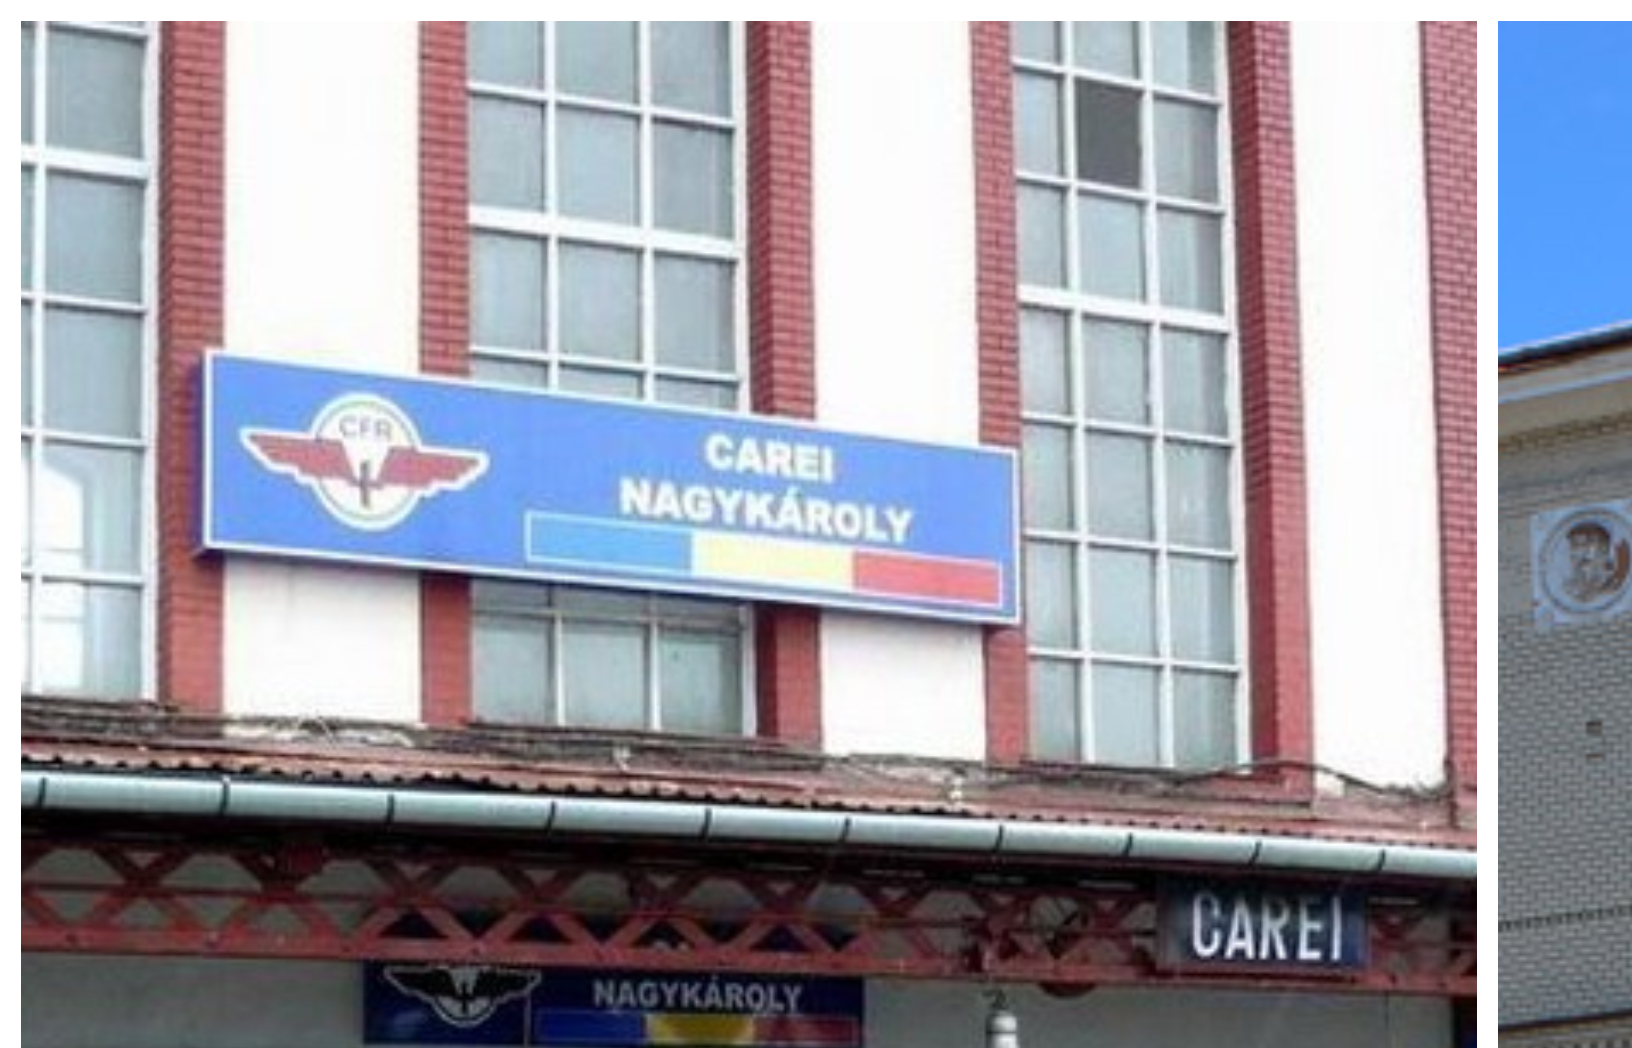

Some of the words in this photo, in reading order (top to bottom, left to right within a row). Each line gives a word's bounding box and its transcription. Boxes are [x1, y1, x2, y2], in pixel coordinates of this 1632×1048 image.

[338, 414, 393, 442] CFR
[704, 433, 834, 483] CAREI
[619, 475, 912, 544] NAGYKÁROLY
[1191, 890, 1344, 961] CAREI
[593, 974, 803, 1010] NAGYKÁROLY
